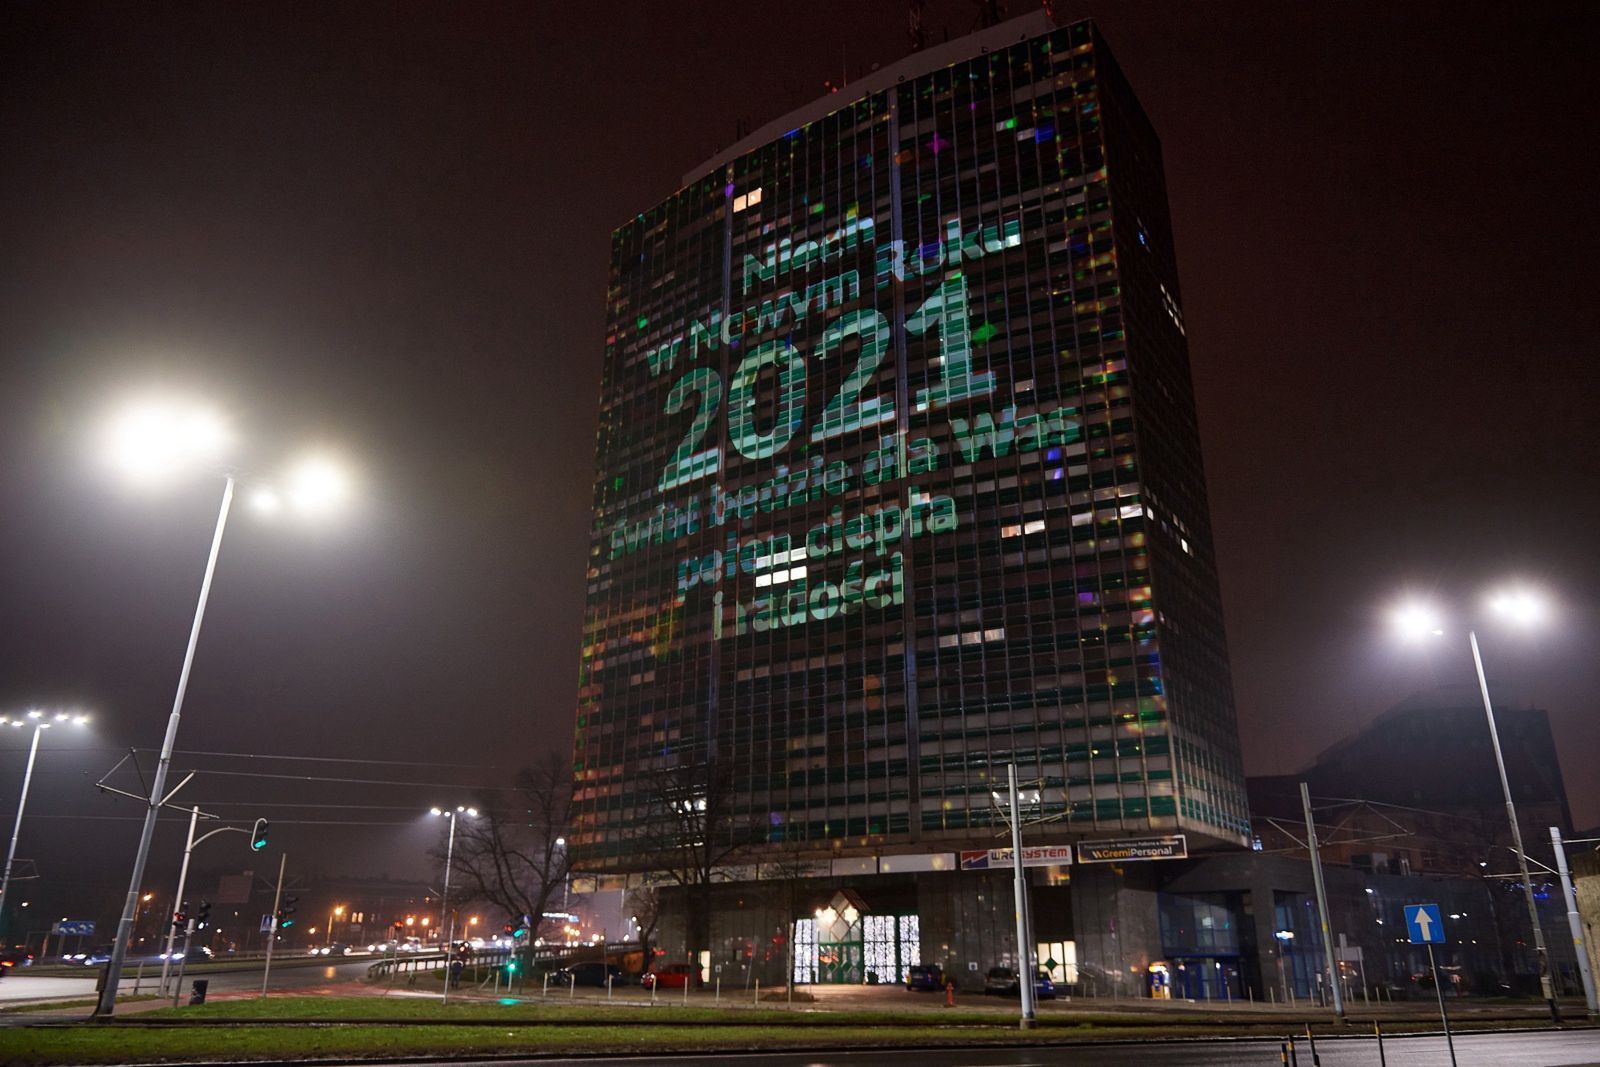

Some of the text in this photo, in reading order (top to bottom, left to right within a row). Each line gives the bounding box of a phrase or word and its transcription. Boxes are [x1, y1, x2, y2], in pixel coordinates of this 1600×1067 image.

[689, 269, 860, 360] Nowym
[876, 217, 1021, 289] Roku
[743, 216, 875, 296] Niech
[657, 273, 998, 494] 2021
[863, 431, 939, 486] dla
[948, 404, 1081, 463] Was
[712, 590, 723, 641] i
[1102, 847, 1172, 858] GremiPersonal
